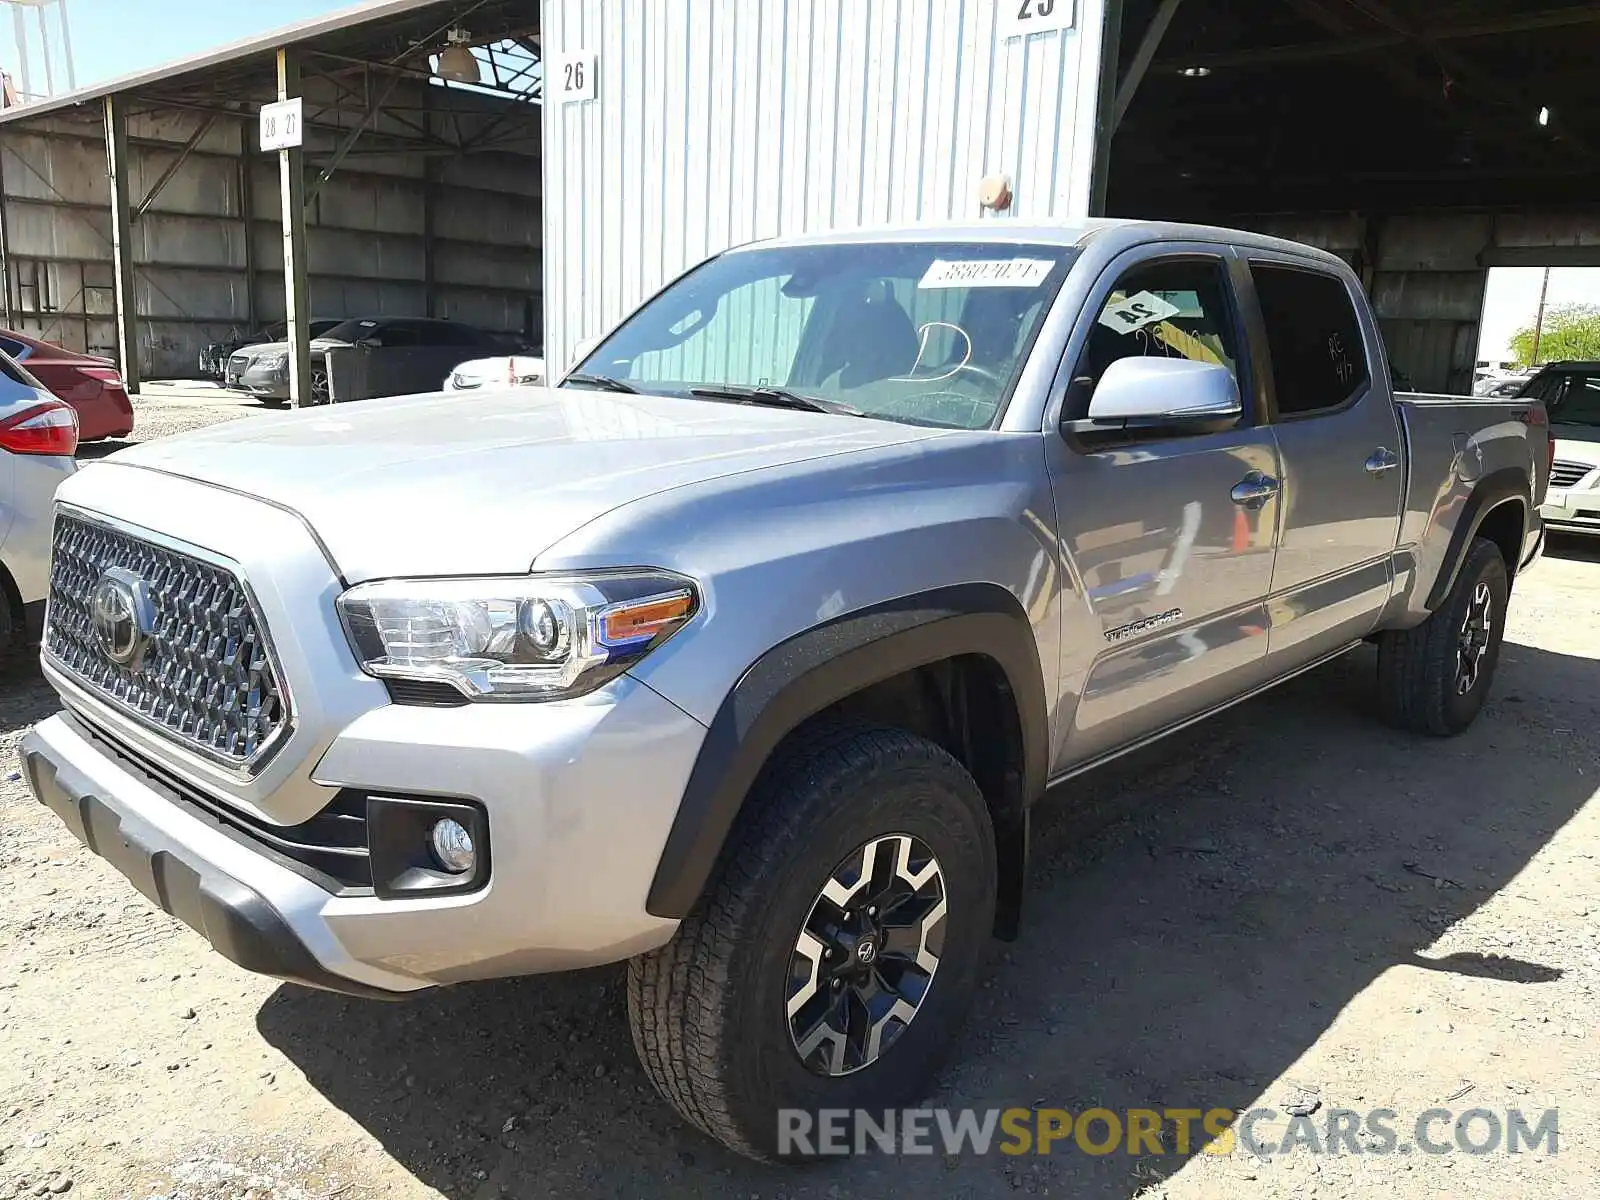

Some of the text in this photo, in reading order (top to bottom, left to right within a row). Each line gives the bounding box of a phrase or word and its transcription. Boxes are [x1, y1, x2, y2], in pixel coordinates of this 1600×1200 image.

[564, 61, 584, 91] 26
[265, 112, 296, 138] 28 27
